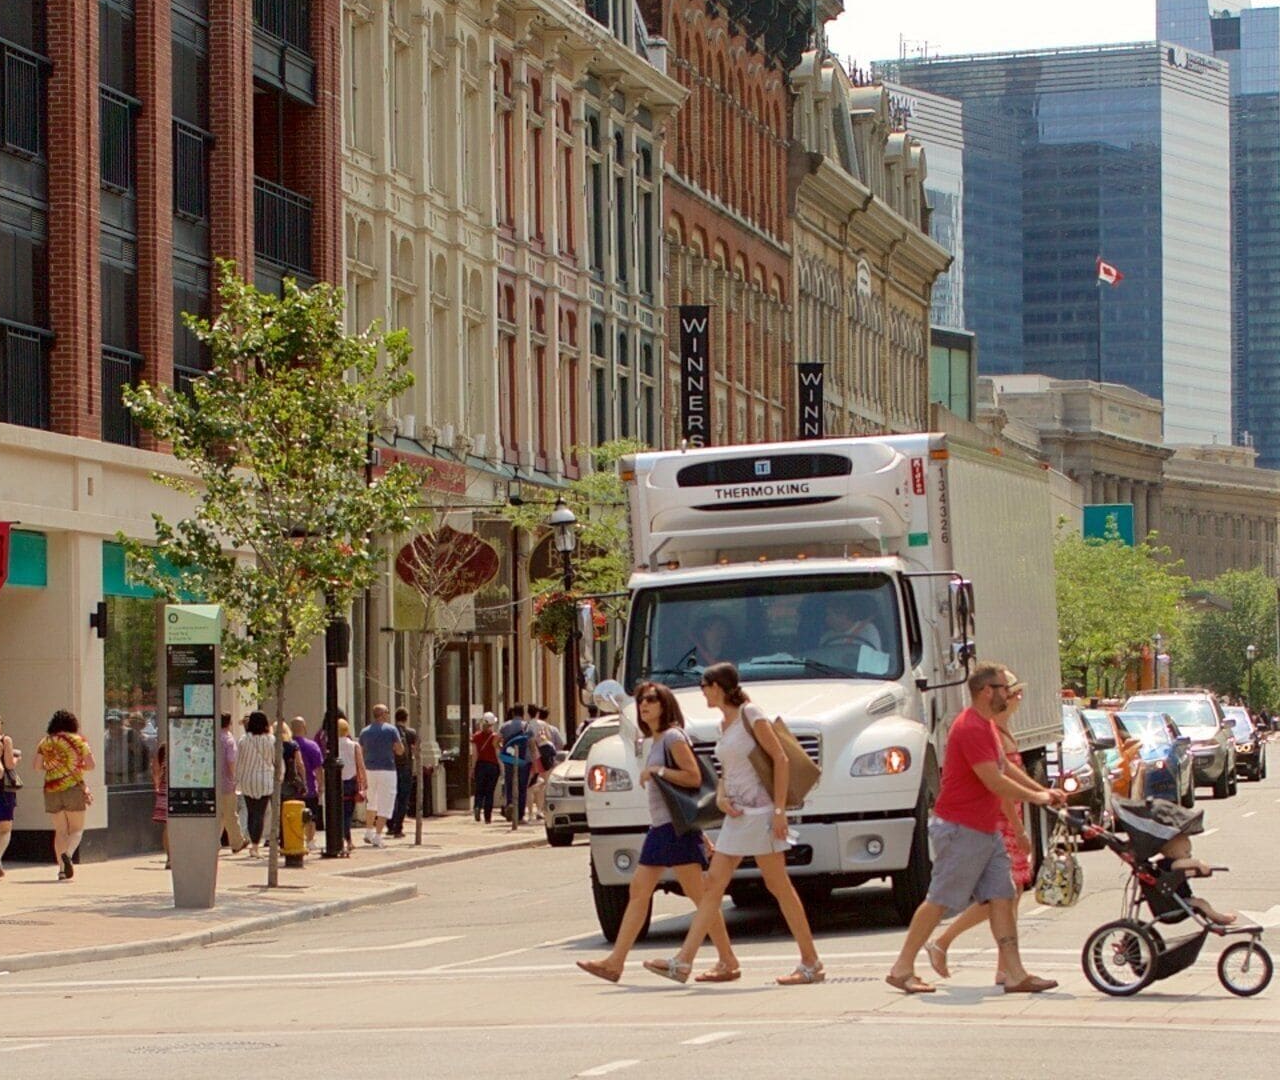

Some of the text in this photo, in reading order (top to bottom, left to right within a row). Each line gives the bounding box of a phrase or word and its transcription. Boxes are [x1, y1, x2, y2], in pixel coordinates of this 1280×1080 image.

[682, 318, 707, 448] WINNERS
[715, 483, 809, 499] THERMO KING
[938, 467, 949, 544] 134326
